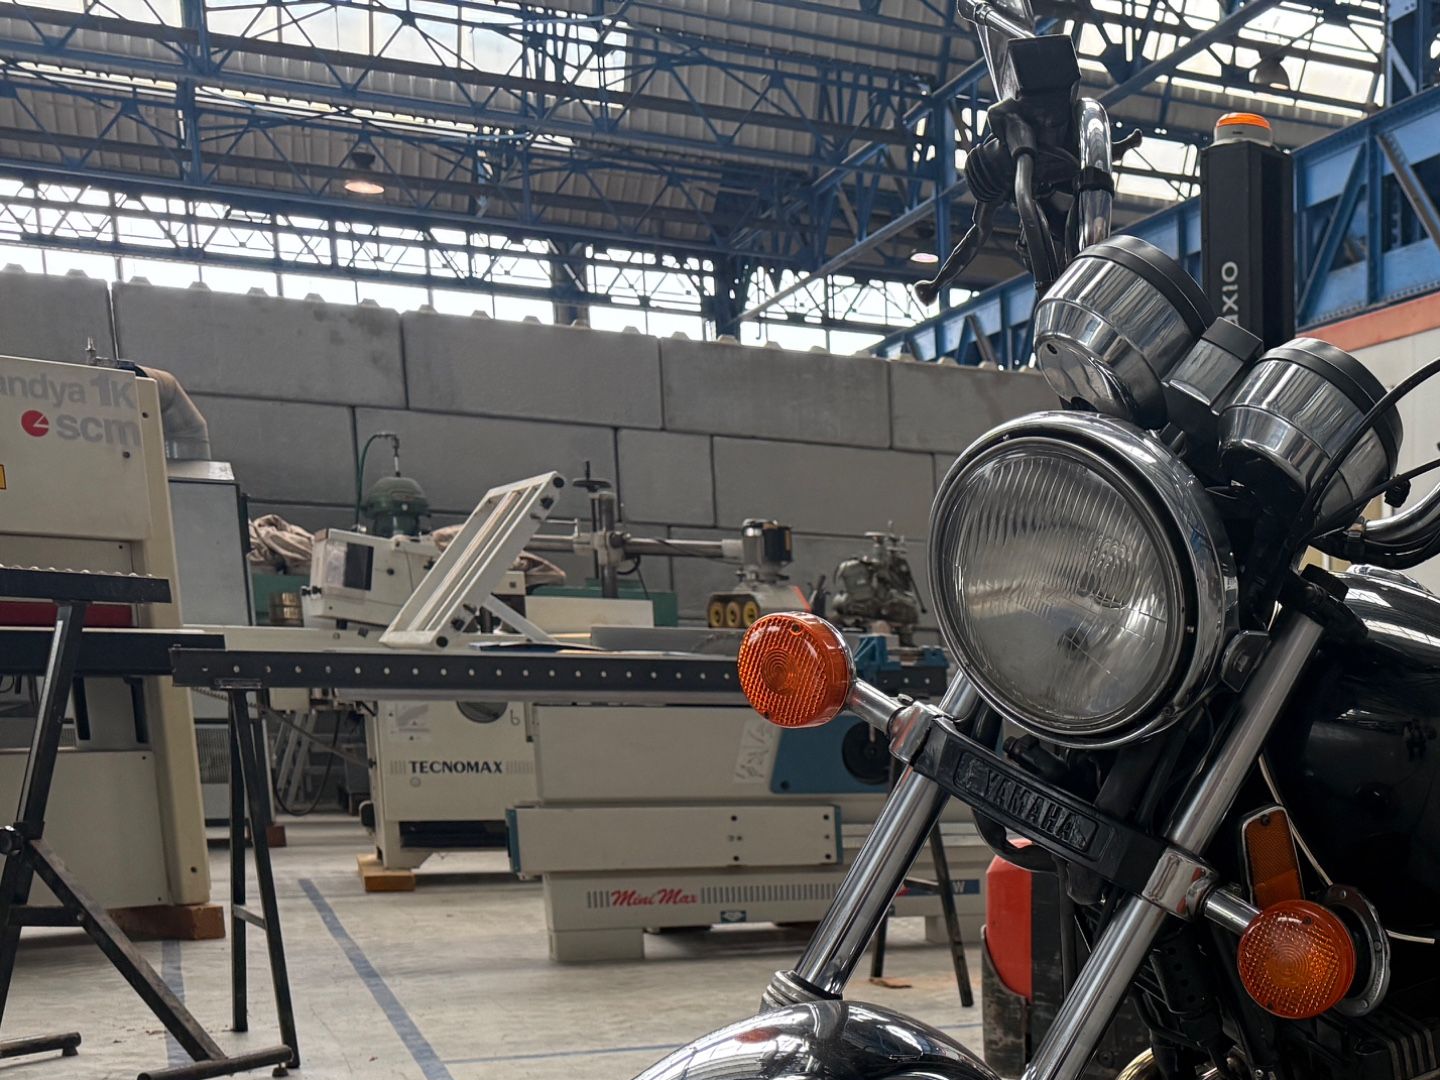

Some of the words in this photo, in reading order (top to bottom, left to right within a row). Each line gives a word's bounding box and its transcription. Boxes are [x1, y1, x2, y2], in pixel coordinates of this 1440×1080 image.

[55, 414, 140, 447] scm
[410, 760, 502, 774] TECNOMAX
[983, 768, 1084, 844] YAMAHA
[611, 889, 653, 907] Mini
[657, 887, 698, 905] Max
